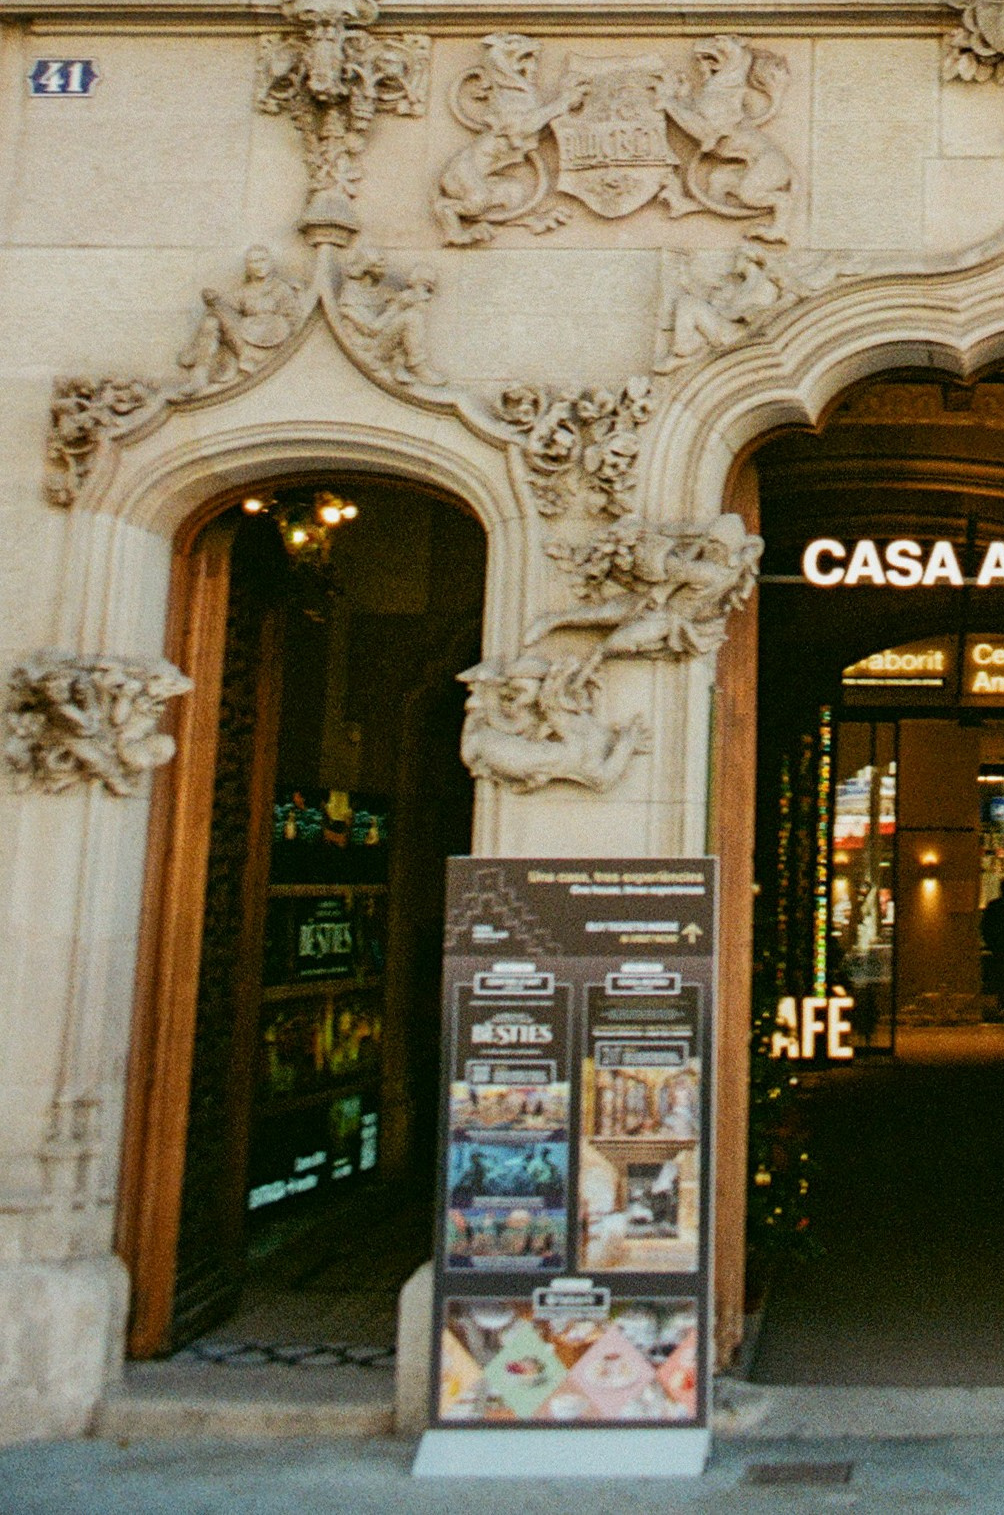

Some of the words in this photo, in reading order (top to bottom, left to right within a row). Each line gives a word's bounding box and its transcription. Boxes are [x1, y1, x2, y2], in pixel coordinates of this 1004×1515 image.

[39, 61, 84, 92] 41
[803, 539, 965, 587] CASA
[860, 649, 944, 671] aborit
[768, 985, 855, 1060] AFÈ
